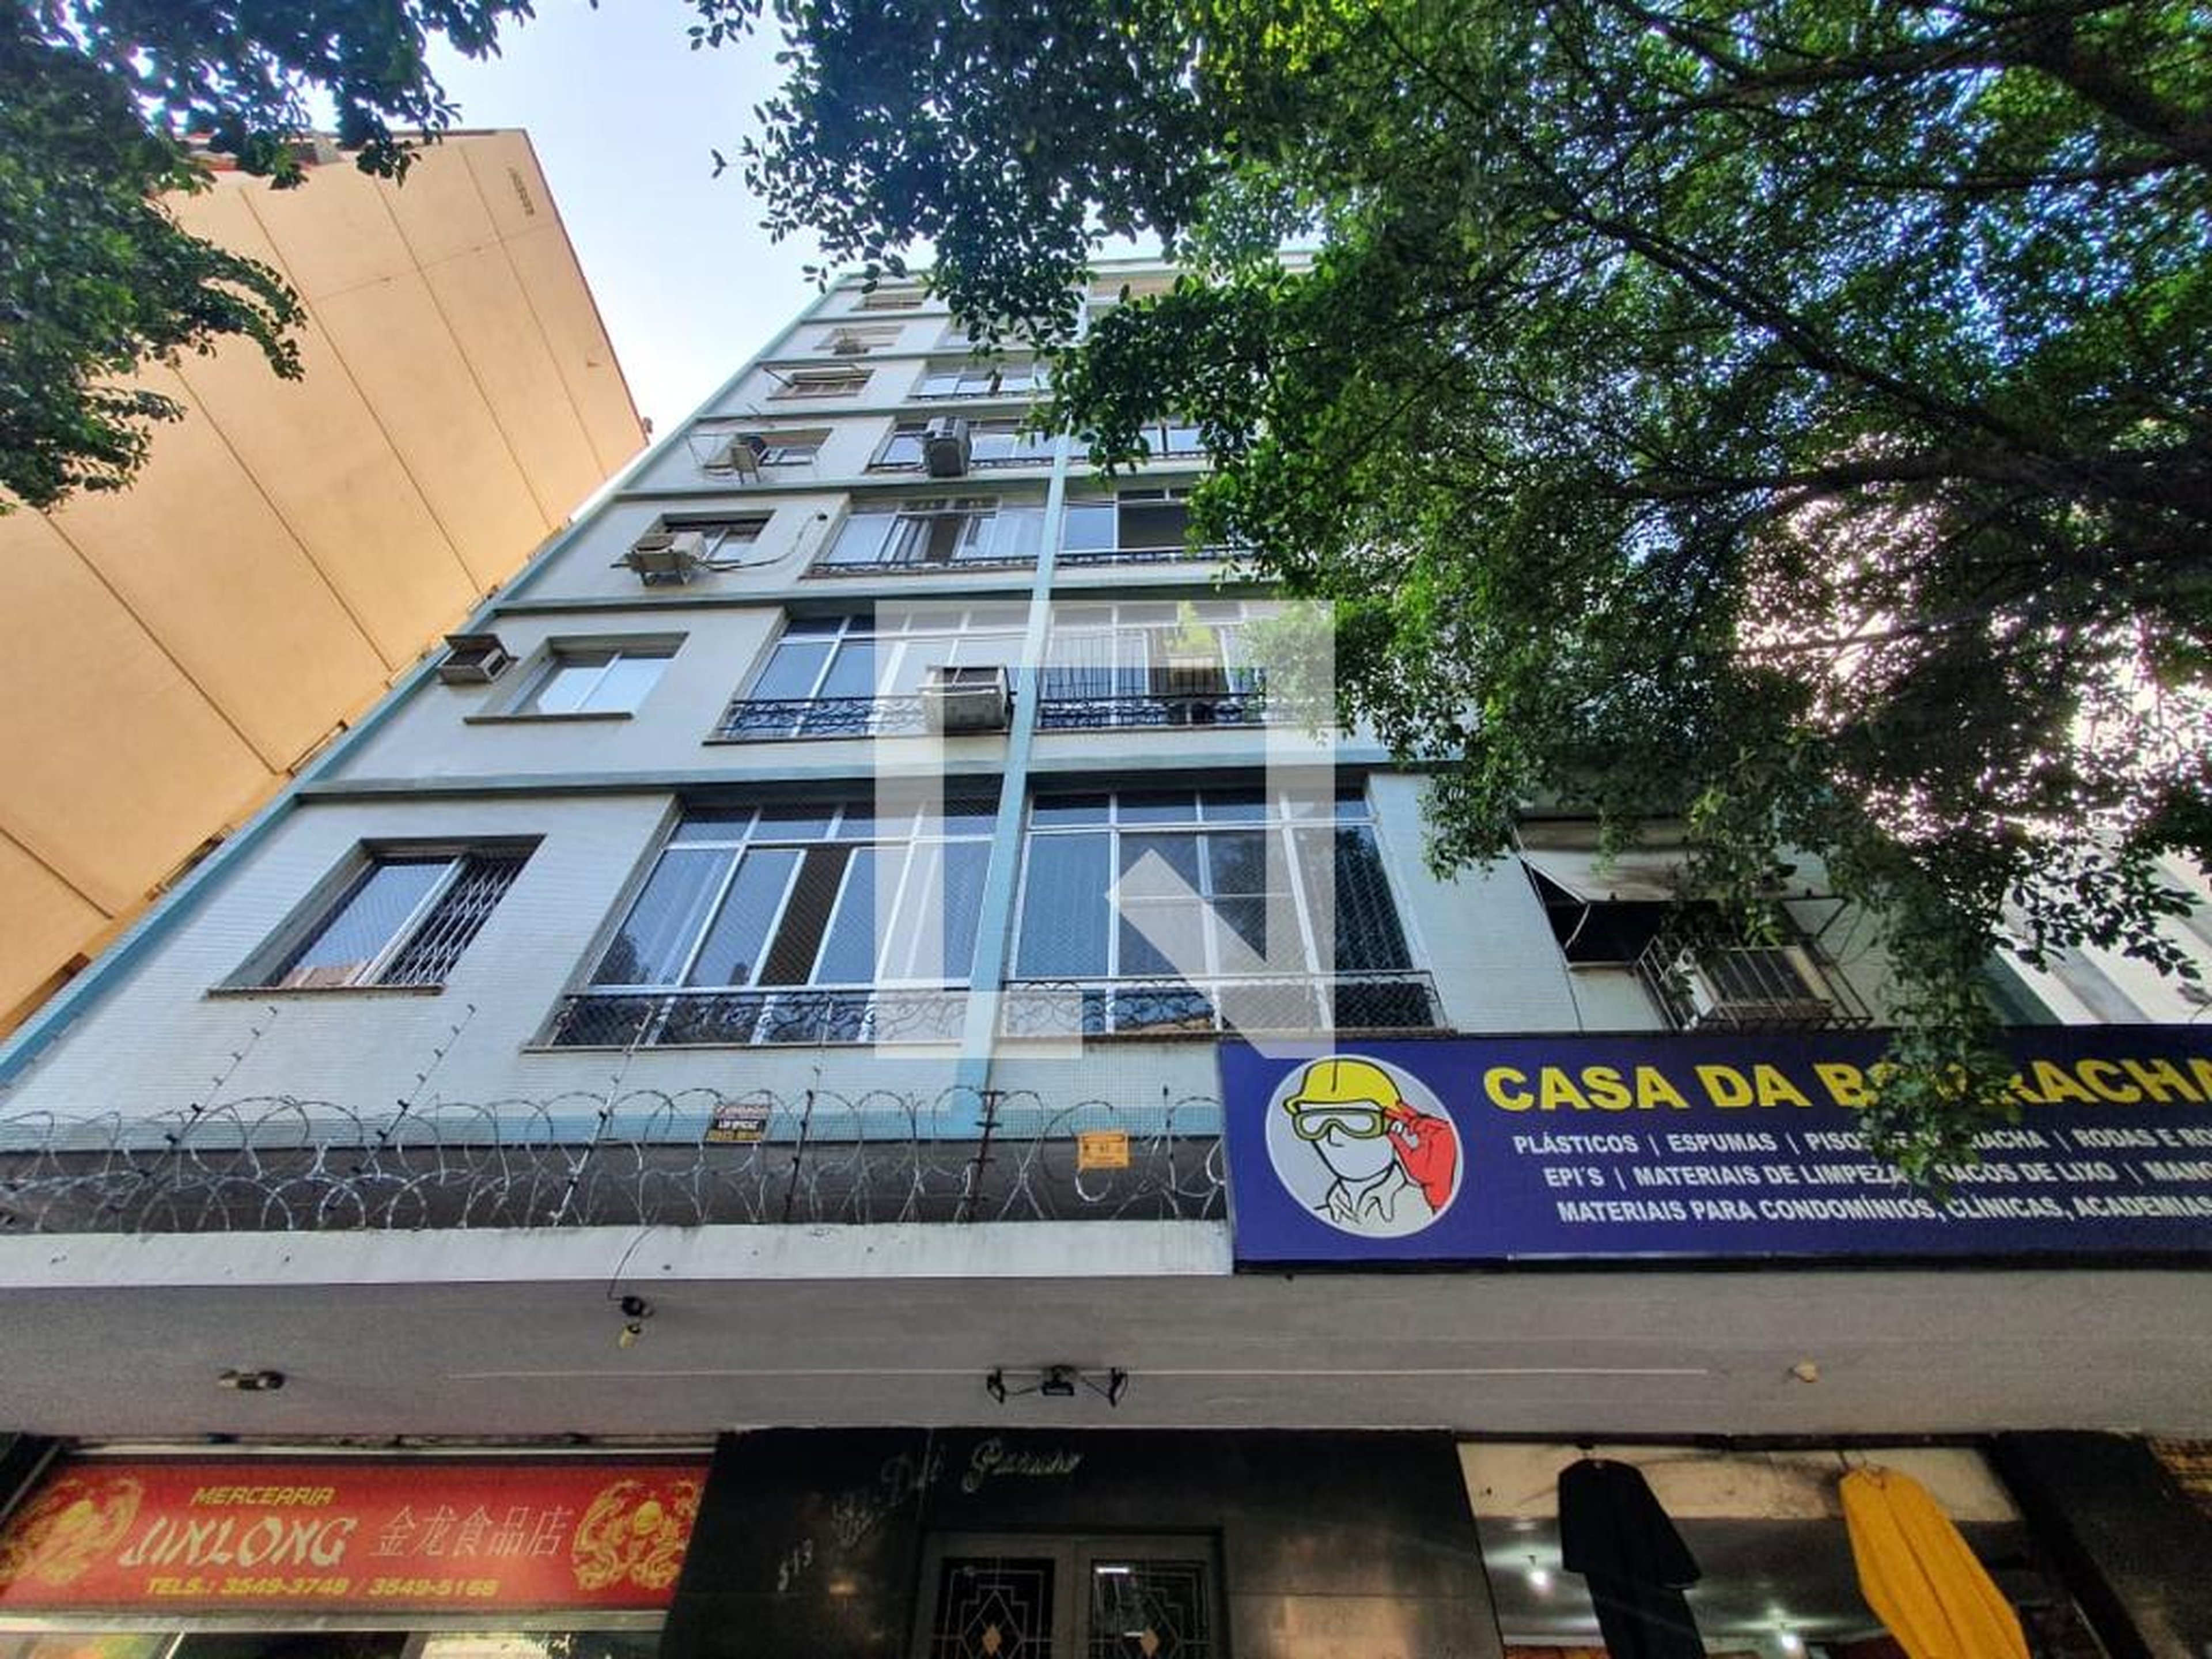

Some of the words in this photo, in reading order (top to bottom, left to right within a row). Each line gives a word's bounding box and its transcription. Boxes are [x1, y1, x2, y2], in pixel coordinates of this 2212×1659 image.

[1483, 1066, 1691, 1111] CASA
[1695, 1065, 1813, 1107] DA
[1813, 1059, 2212, 1107] BACH
[1512, 1131, 1639, 1153] PLÁSTICOS
[1666, 1132, 1778, 1152] ESPUMAS
[2071, 1128, 2158, 1148] RODAS
[2155, 1128, 2182, 1148] E
[1632, 1165, 1761, 1187] MATERIAIS
[1762, 1165, 1800, 1184] DE
[1934, 1162, 2018, 1183] SACOS
[2017, 1162, 2059, 1181] DE
[2054, 1161, 2119, 1181] LIXO
[1556, 1200, 1687, 1222] MATERIAIS
[1688, 1199, 1759, 1221] PARA
[1758, 1192, 1947, 1222] CONDOMÍNIOS,
[190, 1486, 336, 1507] MERCEARIA
[369, 1503, 575, 1557] 金龙食品店
